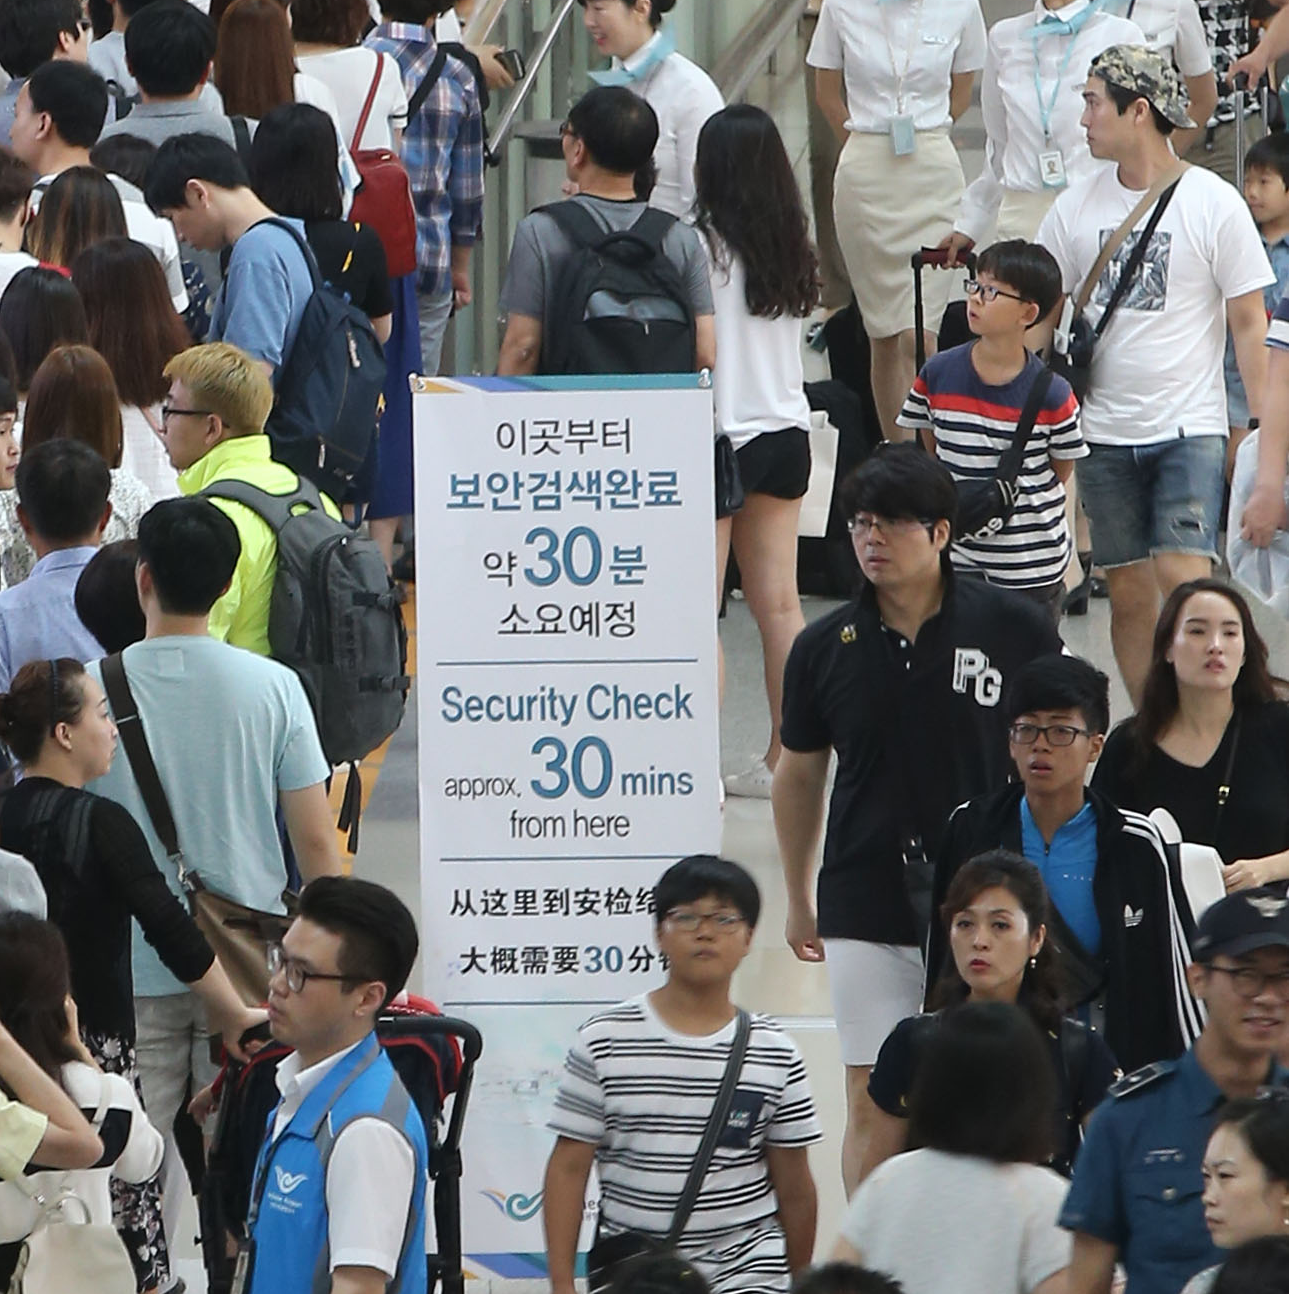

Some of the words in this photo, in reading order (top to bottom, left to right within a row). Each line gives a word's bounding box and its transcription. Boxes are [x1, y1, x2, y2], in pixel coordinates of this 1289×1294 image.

[1107, 259, 1155, 287] HF
[495, 416, 632, 456] 이곳부터
[445, 468, 683, 512] 보안검색완료
[497, 601, 637, 639] 소요예정
[952, 647, 1003, 707] PG
[441, 684, 579, 728] Security
[586, 683, 695, 721] Check
[530, 734, 614, 800] 30
[620, 765, 695, 797] mins
[510, 808, 566, 839] from
[573, 808, 631, 839] here
